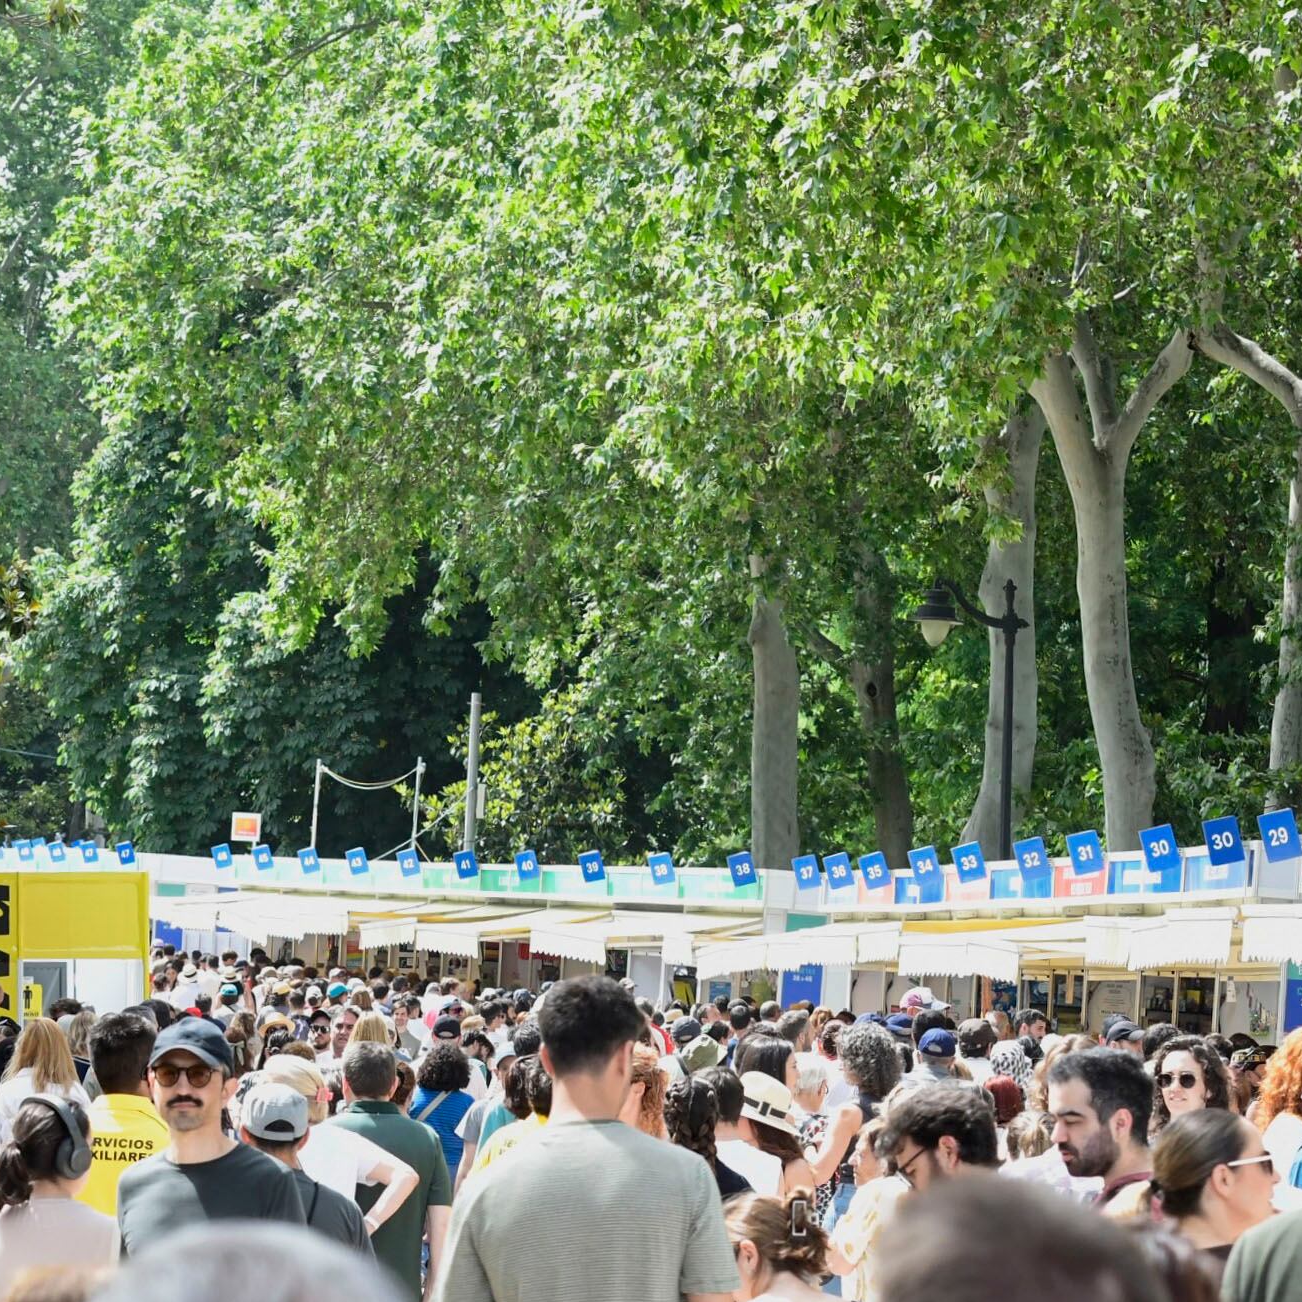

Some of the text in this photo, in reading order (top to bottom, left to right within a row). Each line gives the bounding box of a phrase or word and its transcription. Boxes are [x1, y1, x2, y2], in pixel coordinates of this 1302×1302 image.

[1211, 831, 1234, 851] 30
[1268, 826, 1289, 847] 29
[1077, 844, 1093, 862] 31
[1150, 839, 1170, 858] 30
[460, 858, 472, 870] 41
[521, 860, 535, 871] 40
[585, 860, 600, 873] 39
[916, 858, 933, 874] 34
[960, 854, 978, 871] 33
[1022, 851, 1041, 868] 32
[735, 862, 751, 877] 38
[799, 865, 814, 880] 37
[832, 864, 847, 879] 36
[866, 864, 883, 880] 35
[92, 1136, 154, 1150] RVICIOS
[91, 1149, 153, 1162] XILIARE
